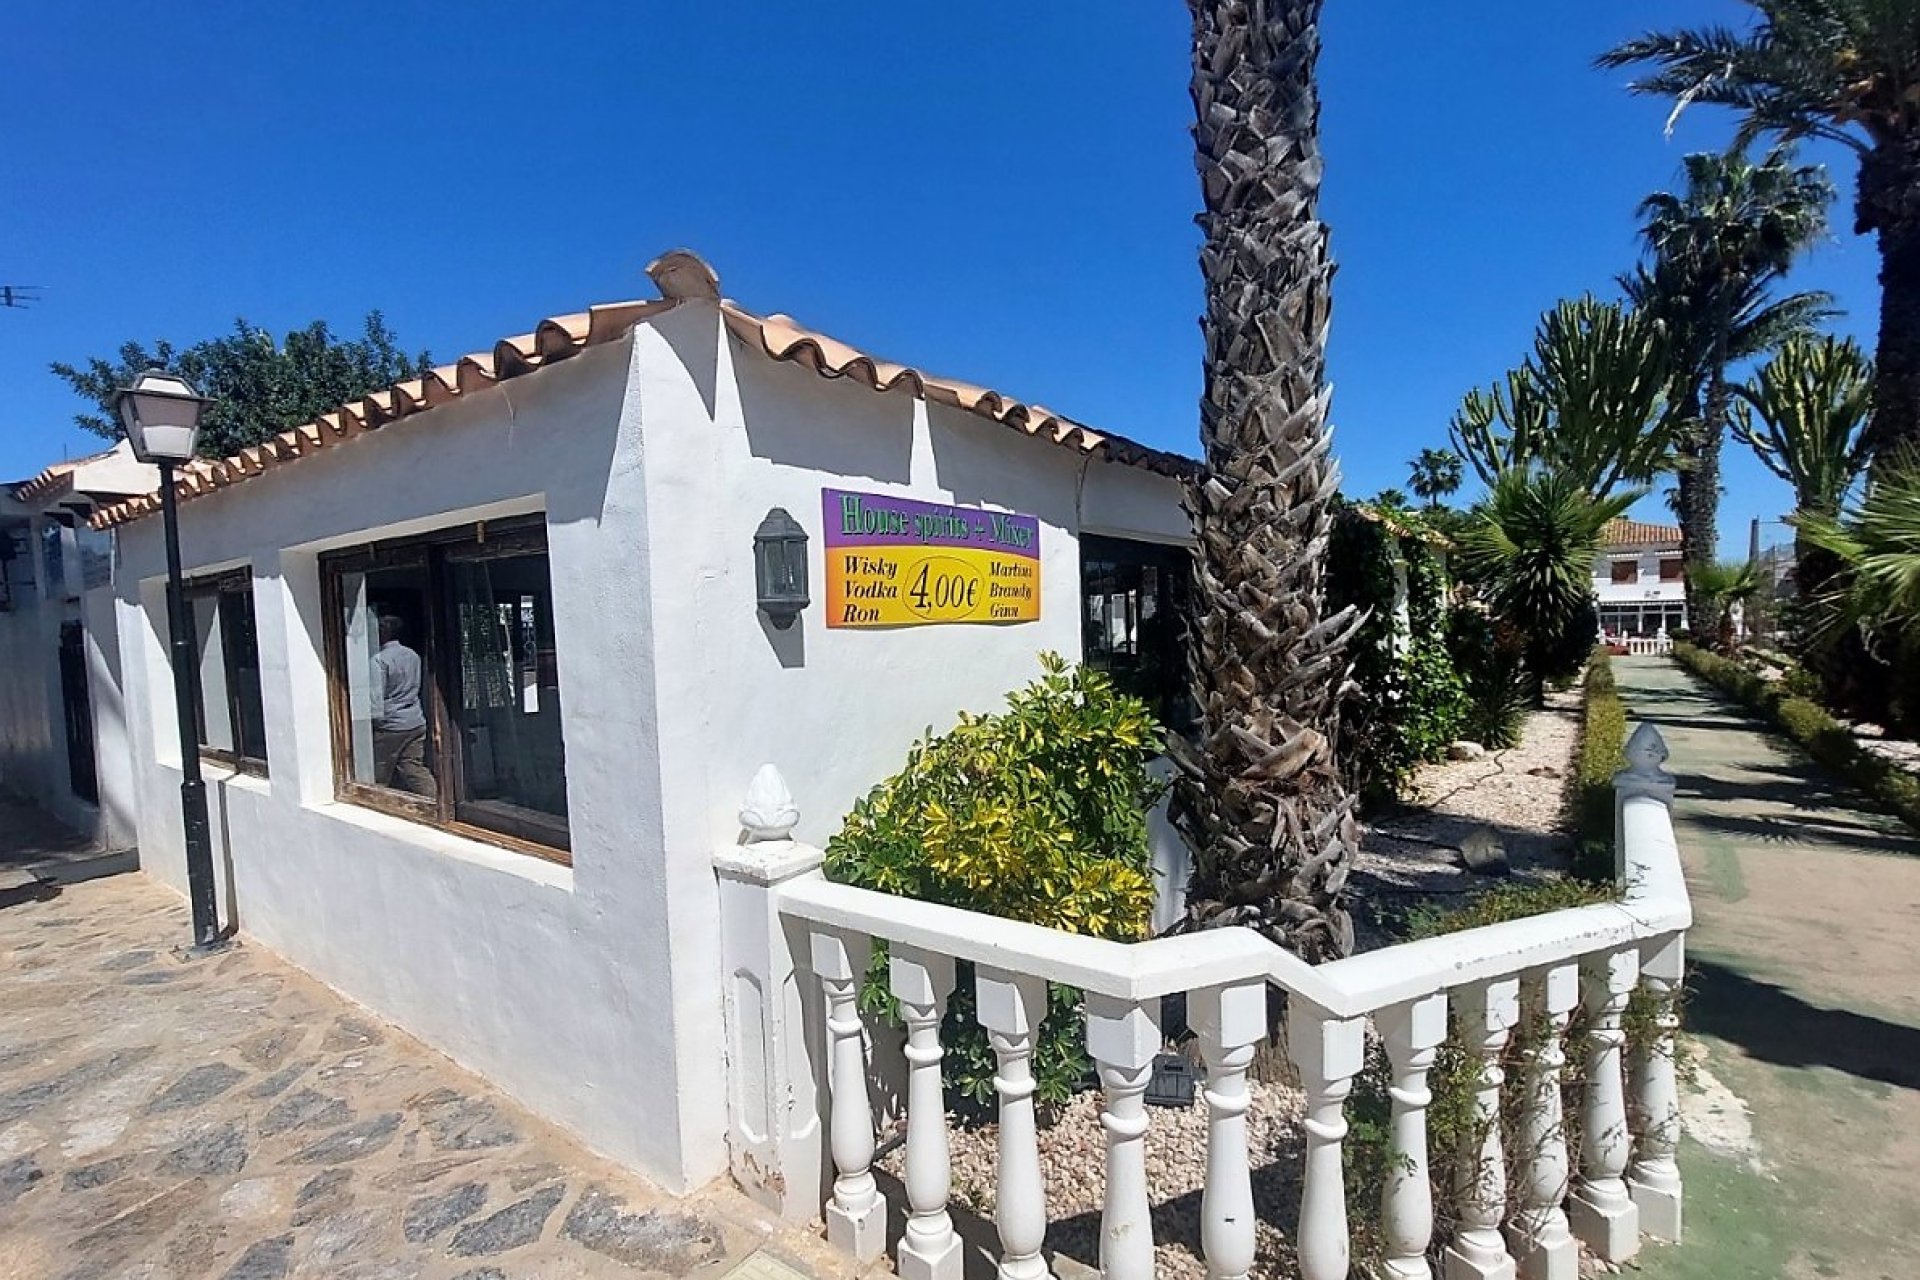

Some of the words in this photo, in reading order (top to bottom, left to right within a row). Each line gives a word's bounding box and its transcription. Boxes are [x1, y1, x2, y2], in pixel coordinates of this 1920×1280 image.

[840, 494, 909, 535] House
[914, 506, 969, 544] spirits
[988, 512, 1034, 549] Mixer
[844, 555, 898, 580] Wisky
[844, 580, 898, 599] Vodka
[909, 562, 978, 614] 4,00€
[843, 603, 880, 622] Ron
